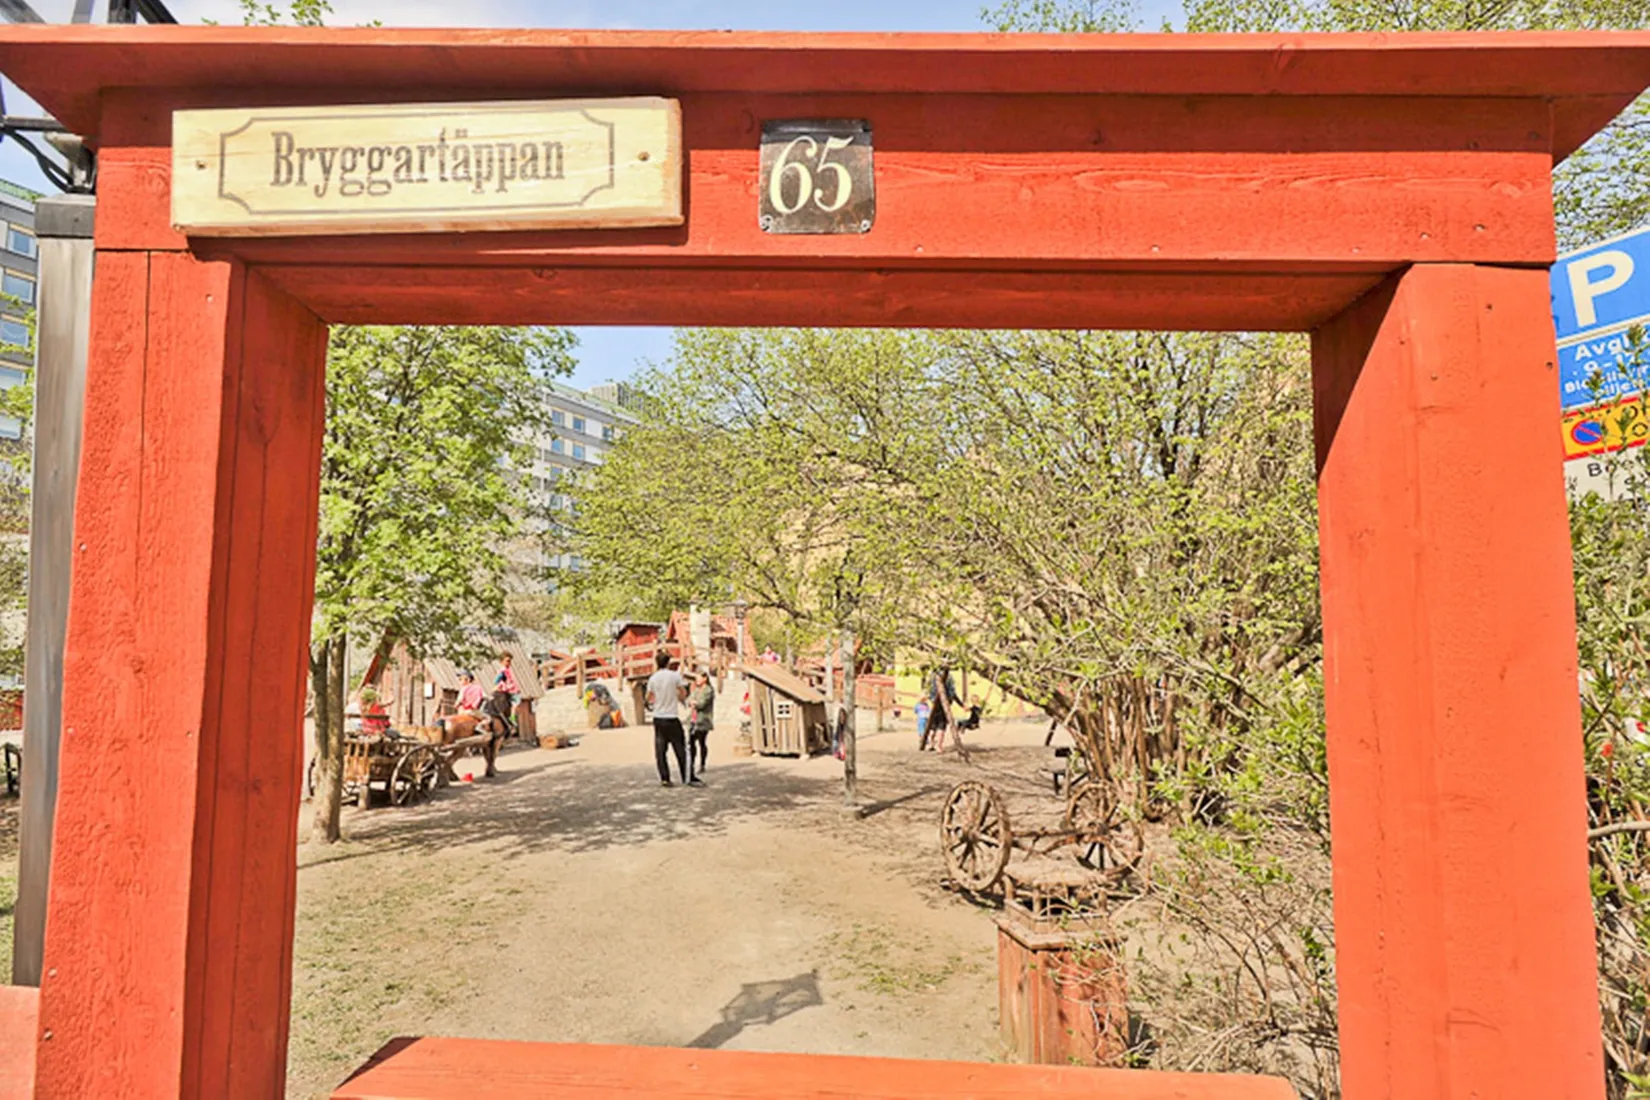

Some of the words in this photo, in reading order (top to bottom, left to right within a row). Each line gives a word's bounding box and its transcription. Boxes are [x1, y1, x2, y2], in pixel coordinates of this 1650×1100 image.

[270, 127, 566, 198] Bryggartäppan
[769, 135, 854, 214] 65
[1566, 250, 1635, 328] P
